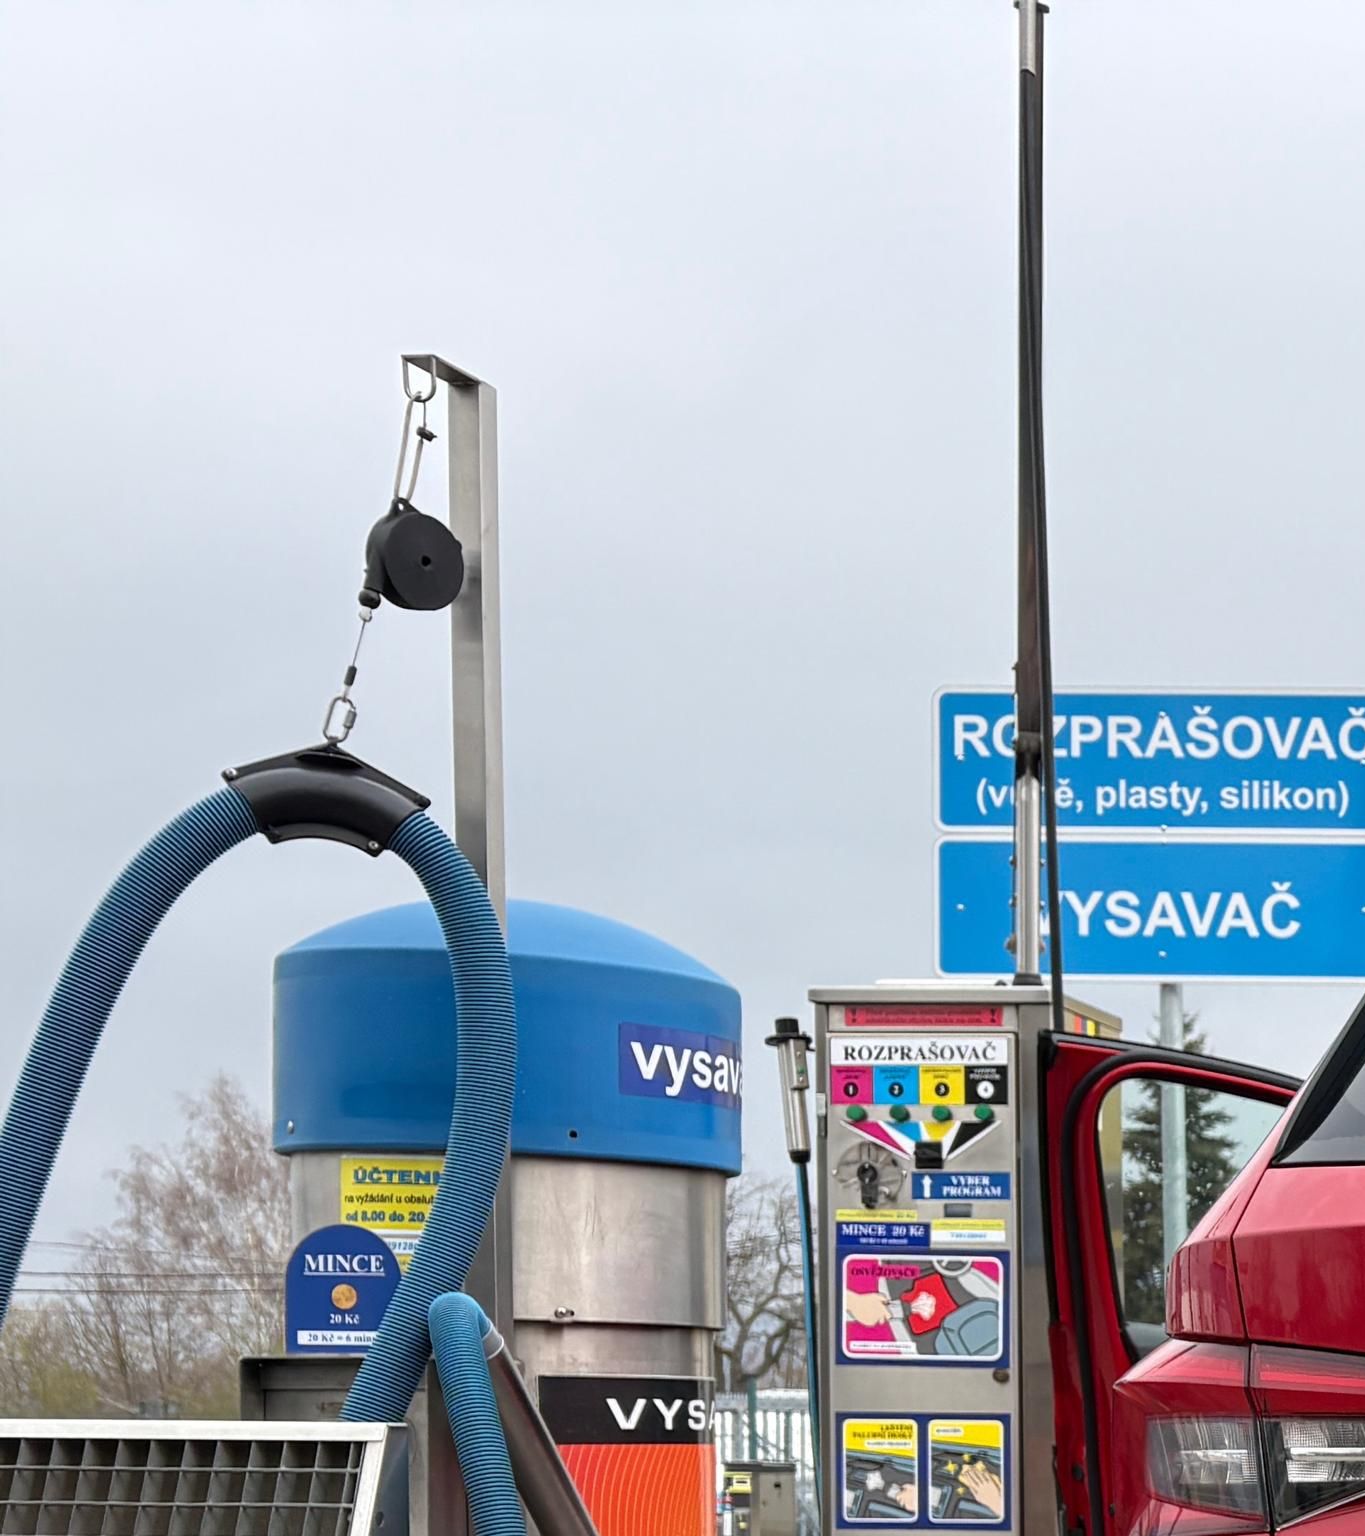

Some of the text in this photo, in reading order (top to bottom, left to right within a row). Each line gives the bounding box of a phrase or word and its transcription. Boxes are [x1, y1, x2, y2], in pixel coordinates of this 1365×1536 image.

[976, 777, 1350, 818] (vě, plasty, silikon)
[843, 1041, 996, 1061] ROZPRAŠOVAČ
[630, 1040, 743, 1097] vysav
[951, 1175, 990, 1186] VYBER
[942, 1186, 1002, 1196] PROGRAM
[344, 1195, 355, 1203] na
[345, 1210, 358, 1222] od
[361, 1211, 386, 1222] 8.00
[389, 1211, 405, 1222] do
[841, 1223, 887, 1237] MINCE
[909, 1225, 926, 1237] Kč
[303, 1254, 385, 1276] MINCE
[329, 1313, 360, 1325] 20 Kč
[307, 1334, 318, 1342] 20
[321, 1333, 335, 1343] Kč
